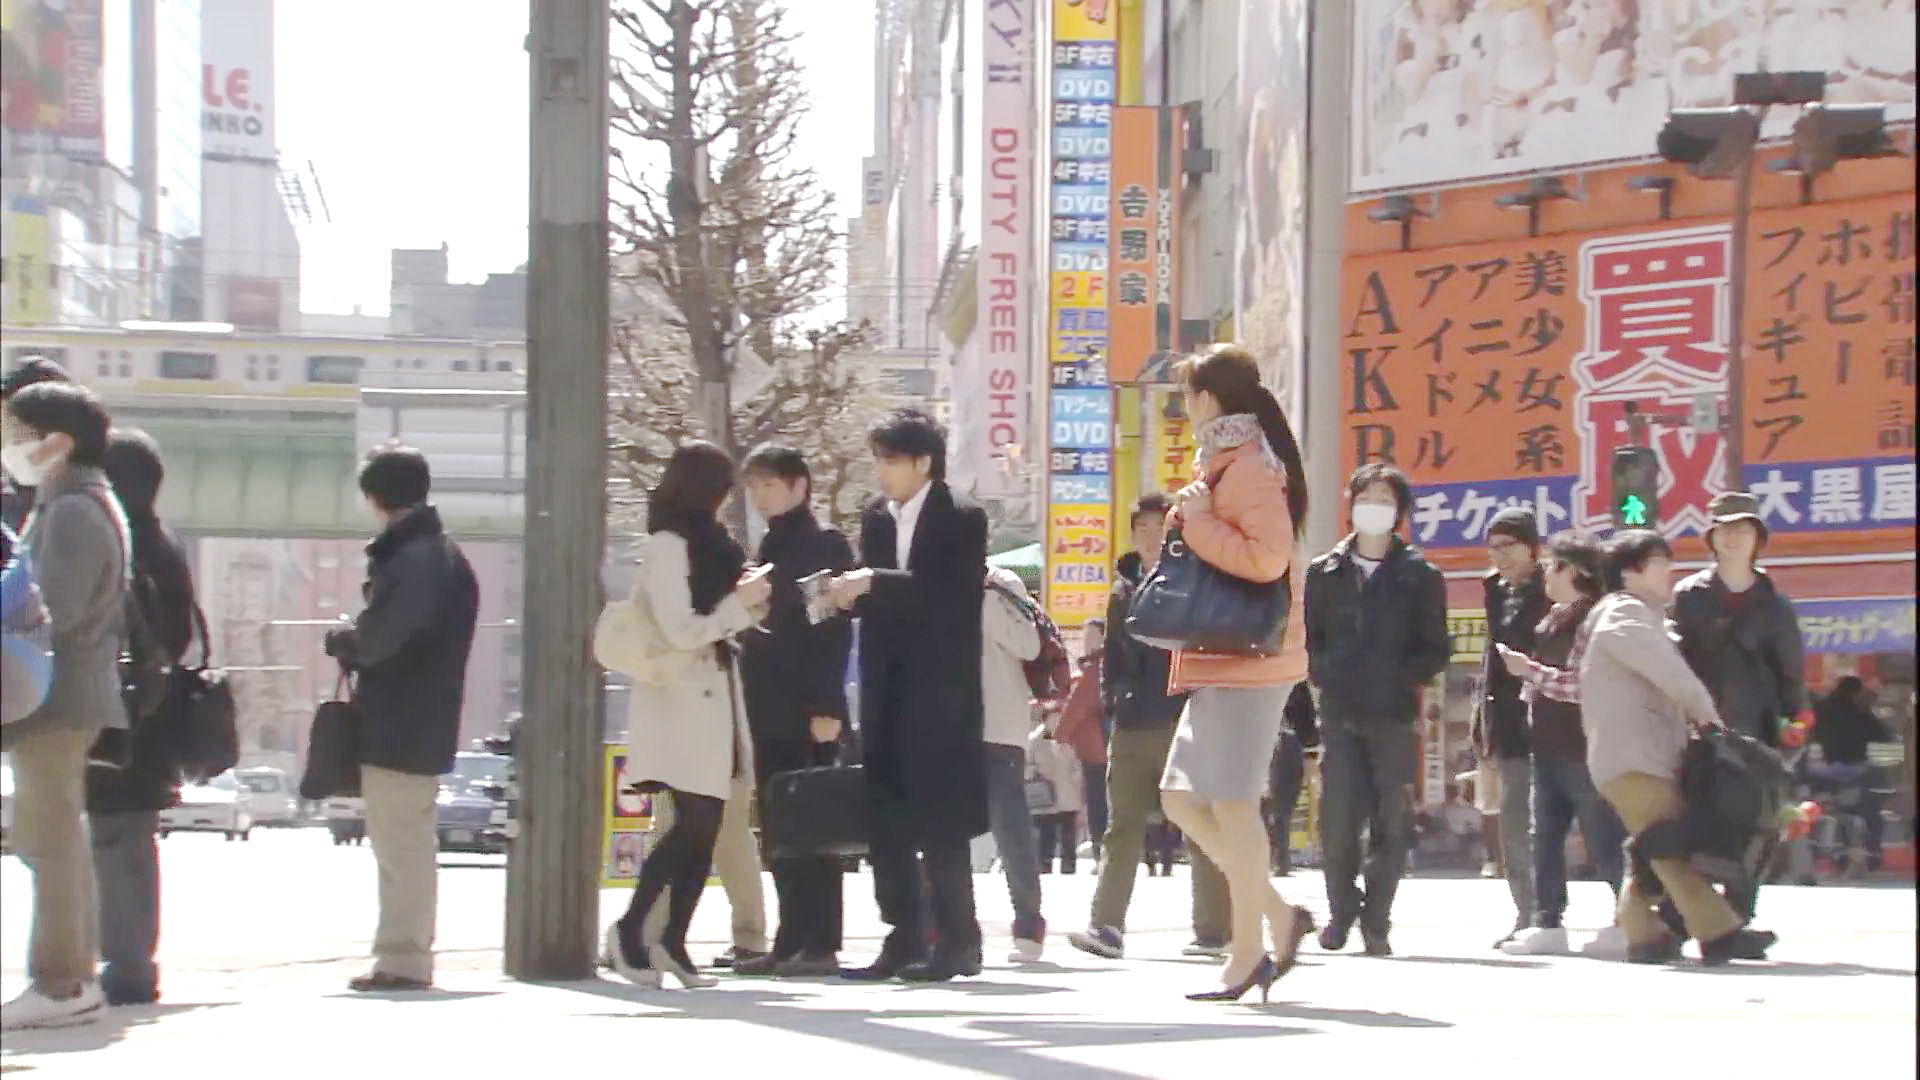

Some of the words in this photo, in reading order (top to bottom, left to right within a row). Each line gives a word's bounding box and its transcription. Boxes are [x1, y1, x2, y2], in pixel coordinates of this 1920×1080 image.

[1059, 79, 1111, 97] DVD
[990, 127, 1018, 235] DUTY
[1058, 137, 1109, 155] DVD
[1057, 195, 1108, 213] DVD
[1119, 185, 1149, 307] 吉野家
[990, 252, 1016, 354] FREE
[1056, 253, 1107, 270] DVD
[1816, 219, 1877, 386] ホビー
[1412, 264, 1458, 470] アイドル
[1464, 257, 1510, 414] アニメ
[1514, 250, 1568, 472] 美少女系
[1577, 227, 1730, 538] 買取
[1753, 226, 1808, 461] フィギュア
[989, 368, 1016, 459] SHO
[1054, 421, 1107, 444] DVD
[1749, 463, 1916, 524] 大黒屋
